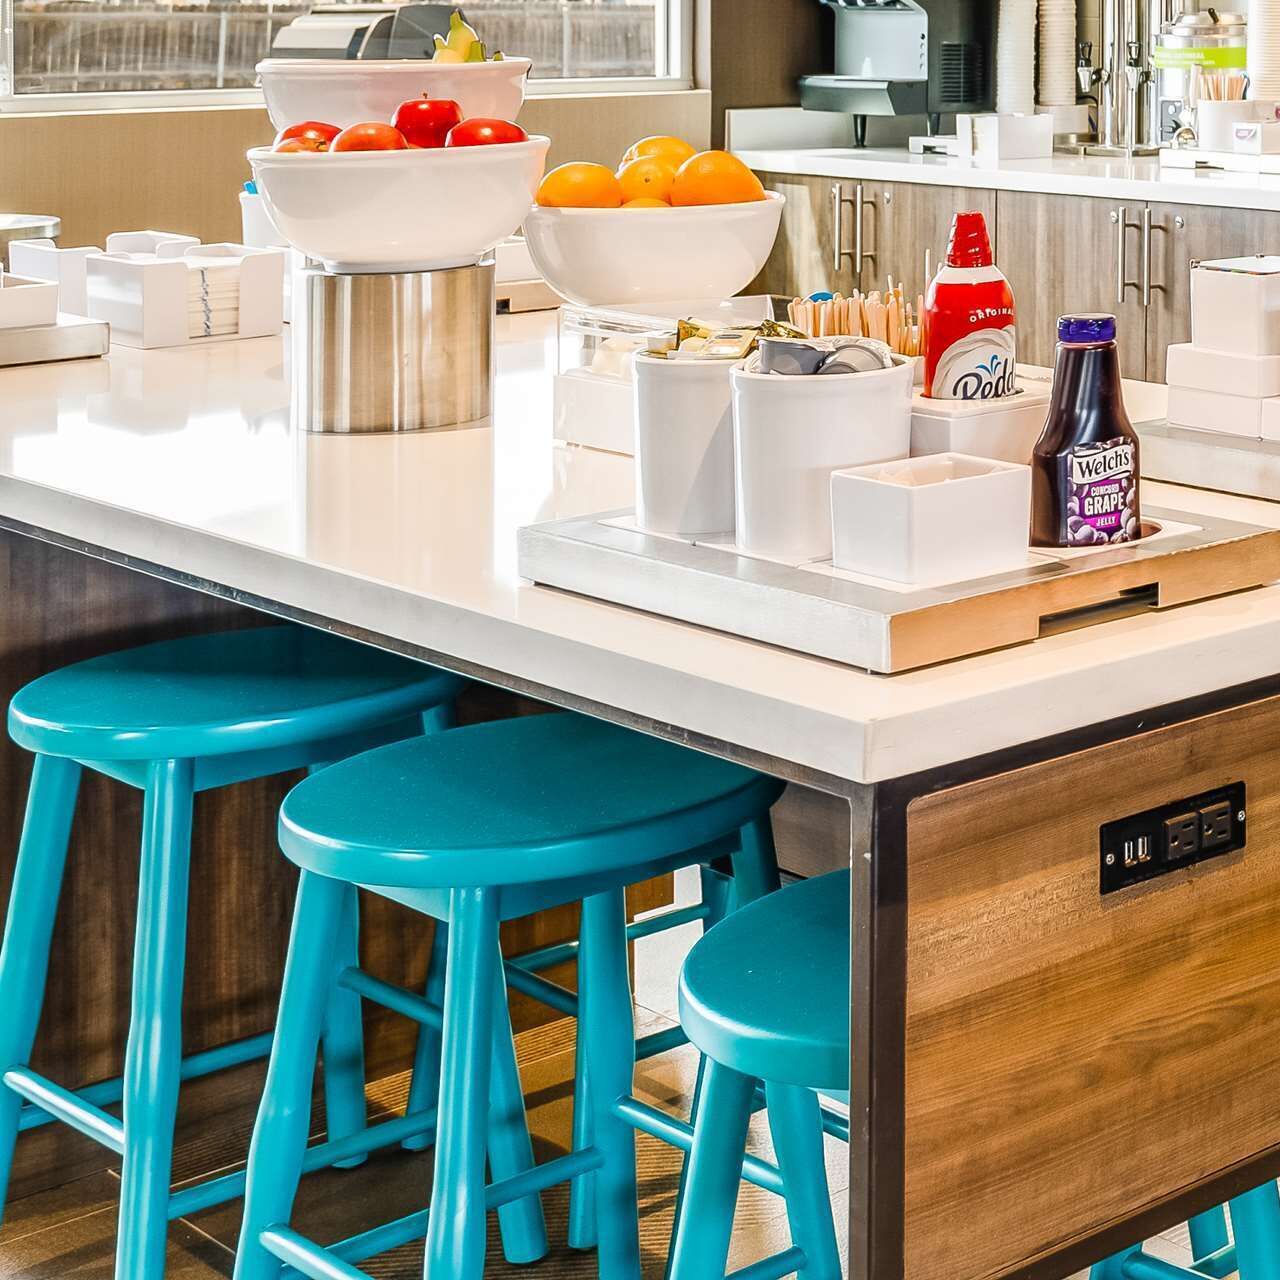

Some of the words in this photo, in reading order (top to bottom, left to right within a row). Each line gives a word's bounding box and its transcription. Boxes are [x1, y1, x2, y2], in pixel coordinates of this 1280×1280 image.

[1076, 448, 1131, 479] Welch's
[1090, 484, 1120, 497] CONCORD
[1084, 492, 1125, 516] GRAPE
[1095, 516, 1117, 527] JELLY
